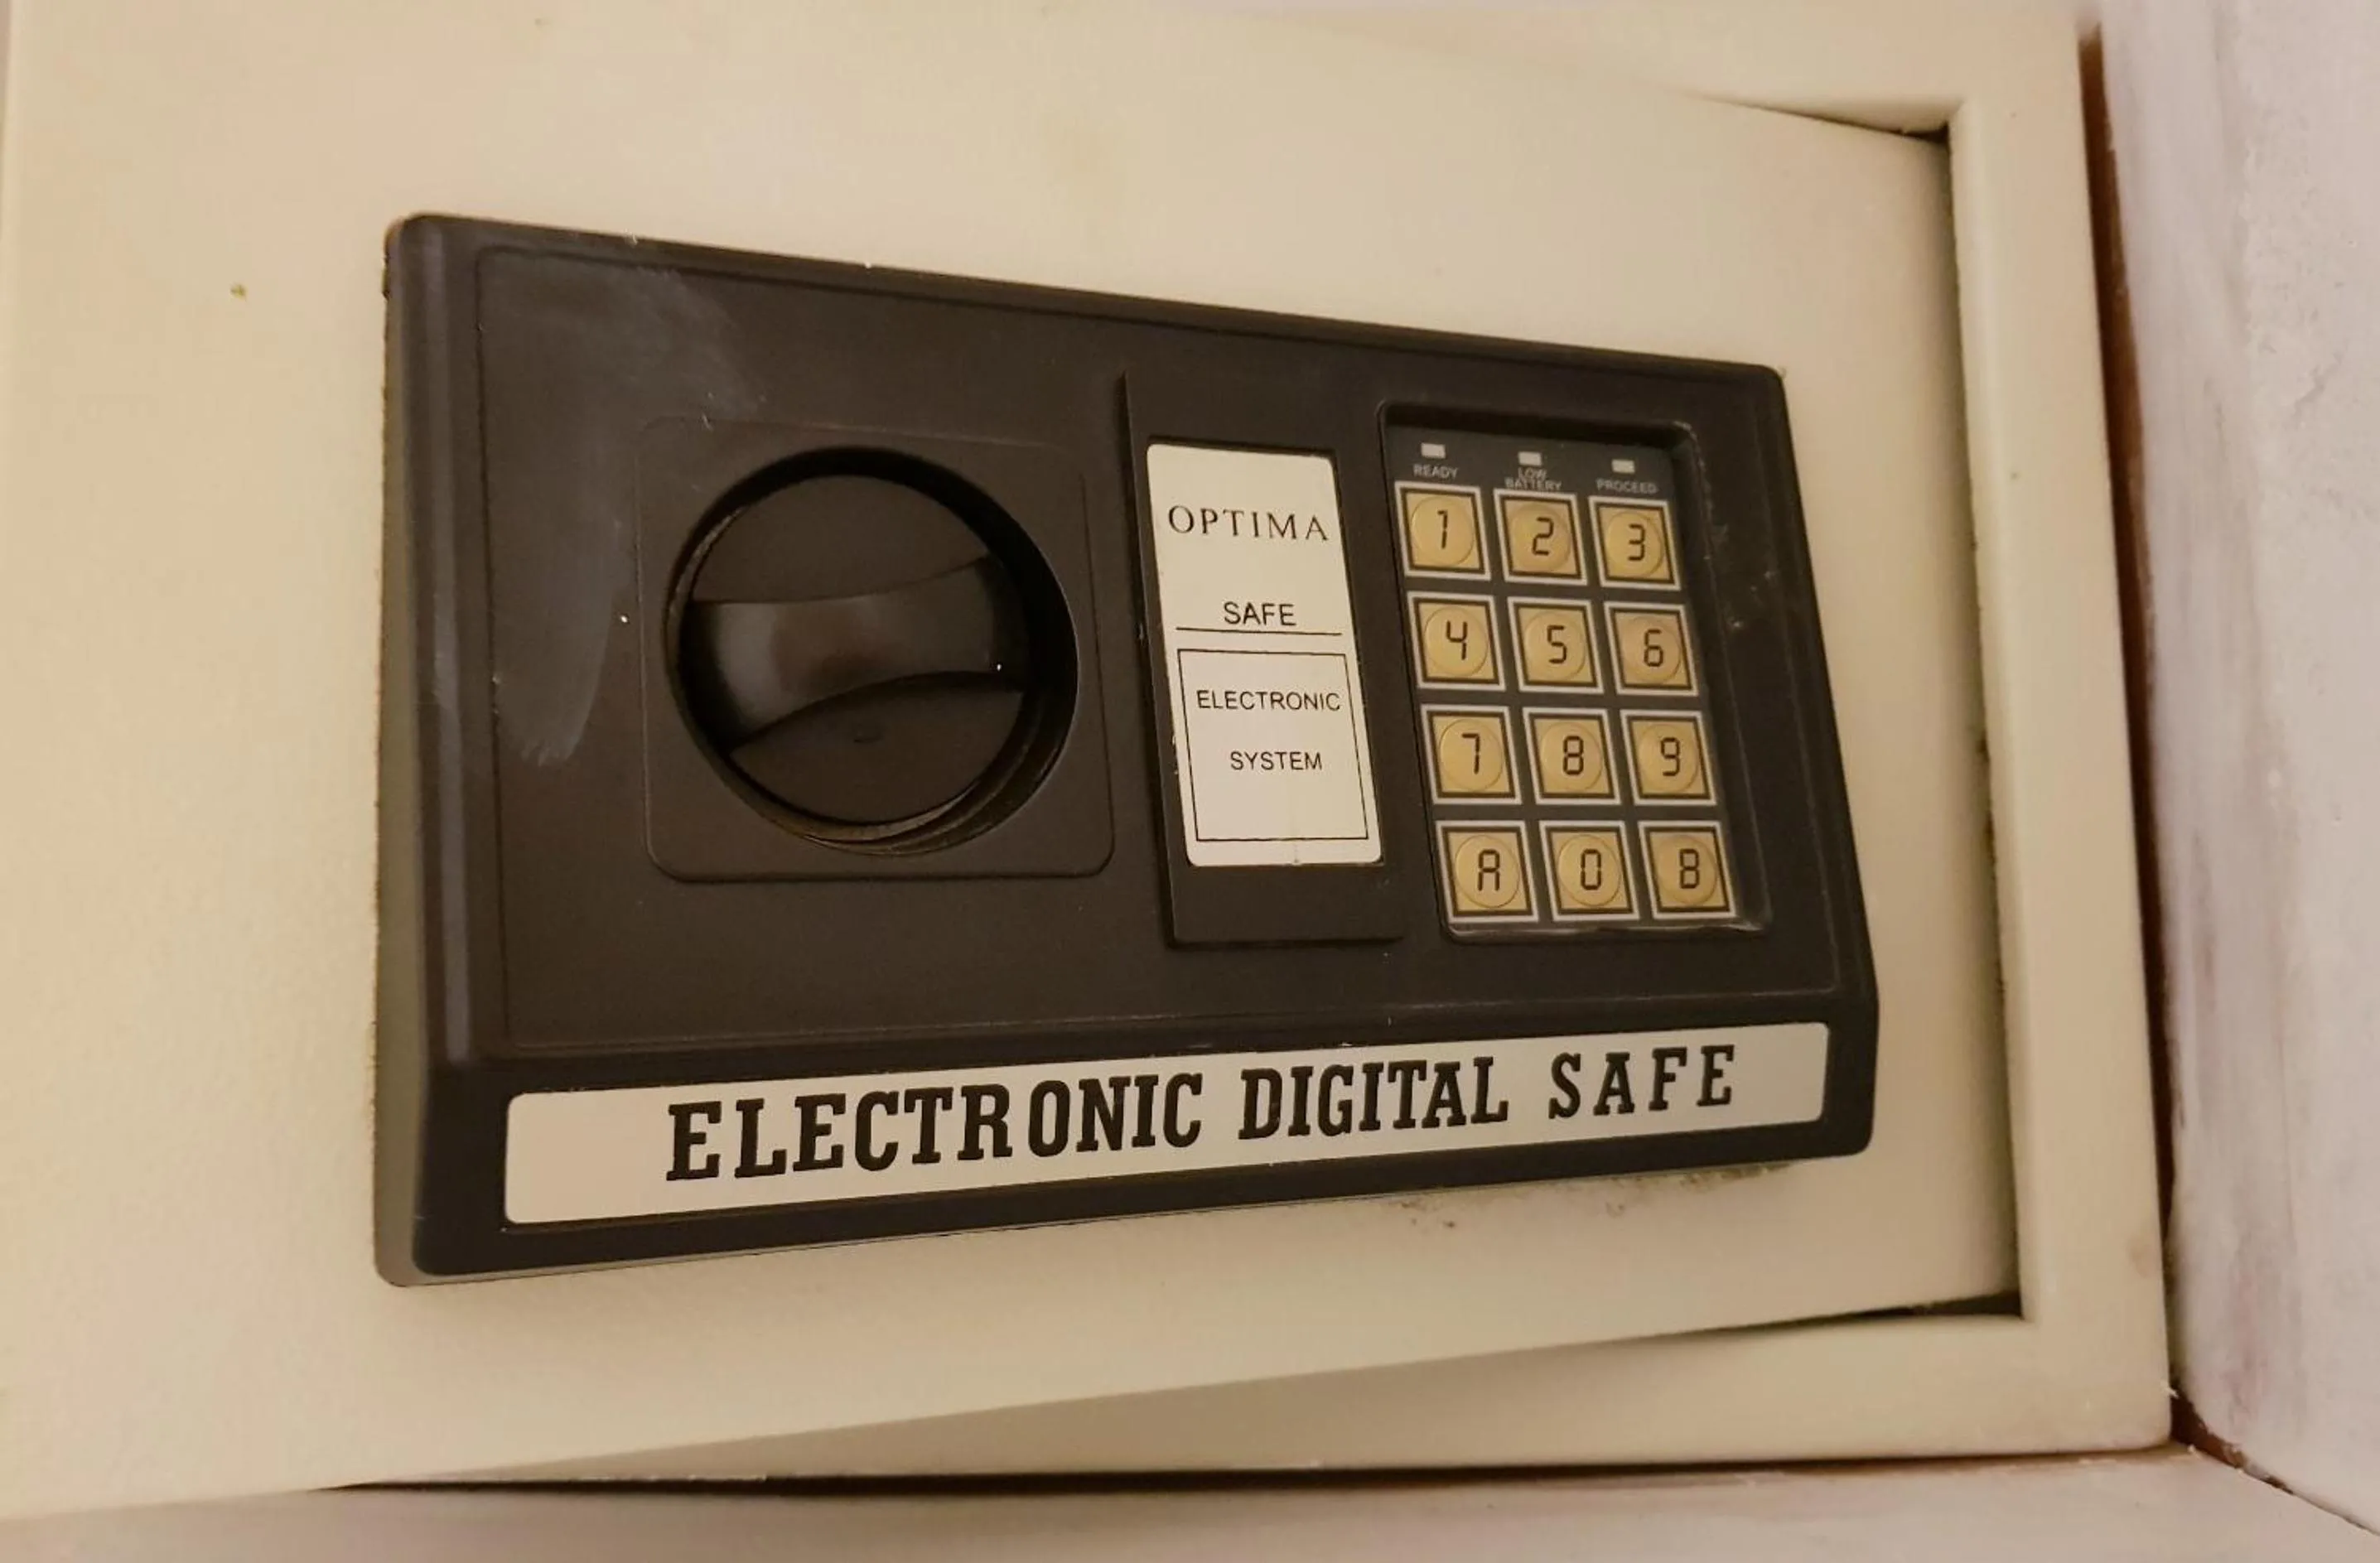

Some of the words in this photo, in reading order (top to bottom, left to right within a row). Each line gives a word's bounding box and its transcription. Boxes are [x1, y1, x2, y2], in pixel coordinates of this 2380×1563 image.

[1412, 464, 1459, 480] READY
[1504, 477, 1562, 492] BATTERY
[1518, 467, 1548, 482] LOW
[1596, 478, 1658, 494] PROCEED
[1168, 505, 1328, 542] OPTIMA
[1436, 509, 1449, 549] 1
[1532, 516, 1555, 557] 2
[1628, 523, 1646, 562] 3
[1224, 601, 1297, 627] SAFE
[1446, 620, 1469, 661] 4
[1547, 625, 1568, 664] 5
[1644, 628, 1664, 668] 6
[1196, 688, 1341, 712] ELECTRONIC
[1230, 750, 1323, 771] SYSTEM
[1461, 732, 1481, 774] 7
[1563, 735, 1585, 776] 8
[1660, 736, 1681, 777] 9
[666, 1071, 1203, 1182] ELECTRONIC
[1238, 1055, 1509, 1141] DIGITAL
[1547, 1044, 1736, 1120] SAFE
